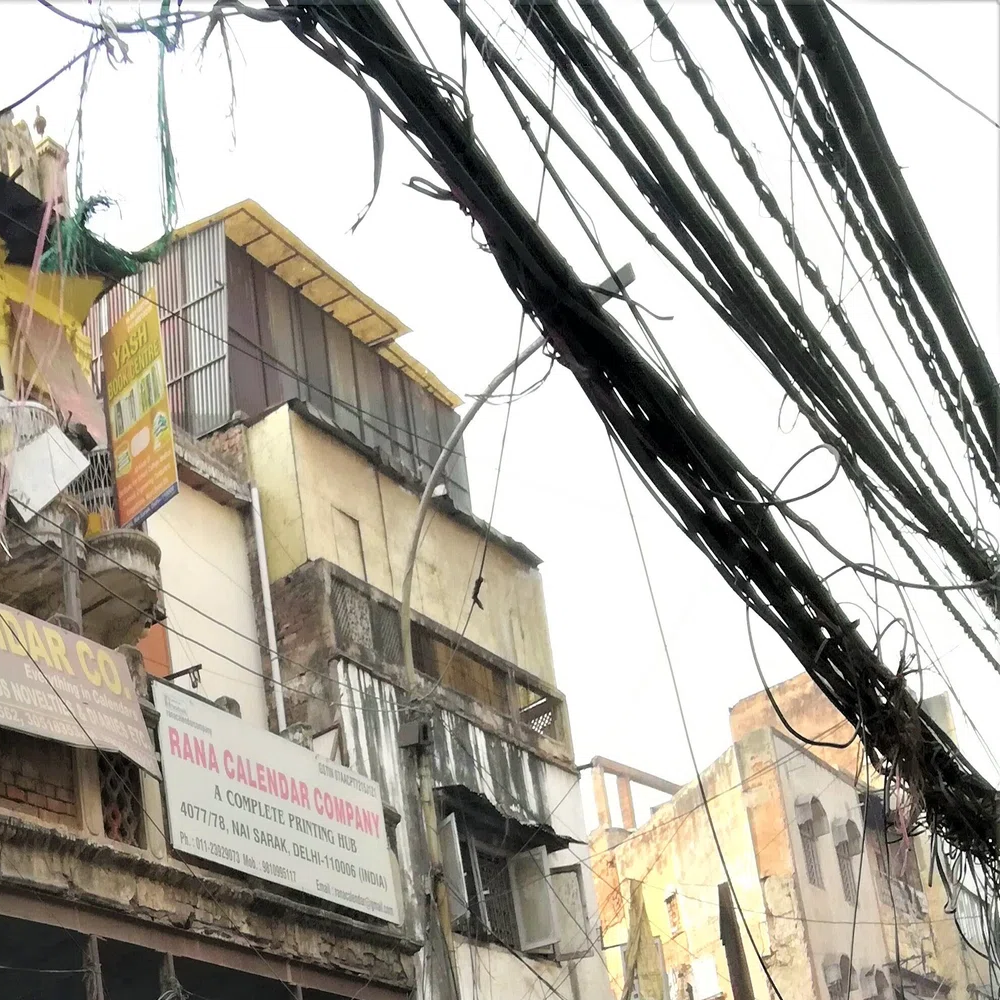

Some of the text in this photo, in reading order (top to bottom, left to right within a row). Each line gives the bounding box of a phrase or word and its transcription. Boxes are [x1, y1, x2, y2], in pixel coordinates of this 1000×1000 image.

[113, 321, 149, 371] YASH
[89, 710, 127, 740] DIARIES
[168, 726, 220, 774] RANA
[223, 749, 311, 811] CALENDAR
[314, 787, 381, 839] COMPANY
[180, 801, 388, 893] 4077/78, NAI SARAK, DELHI-110006 (INDIA)
[213, 785, 358, 854] A COMPLETE PRINTING HUB
